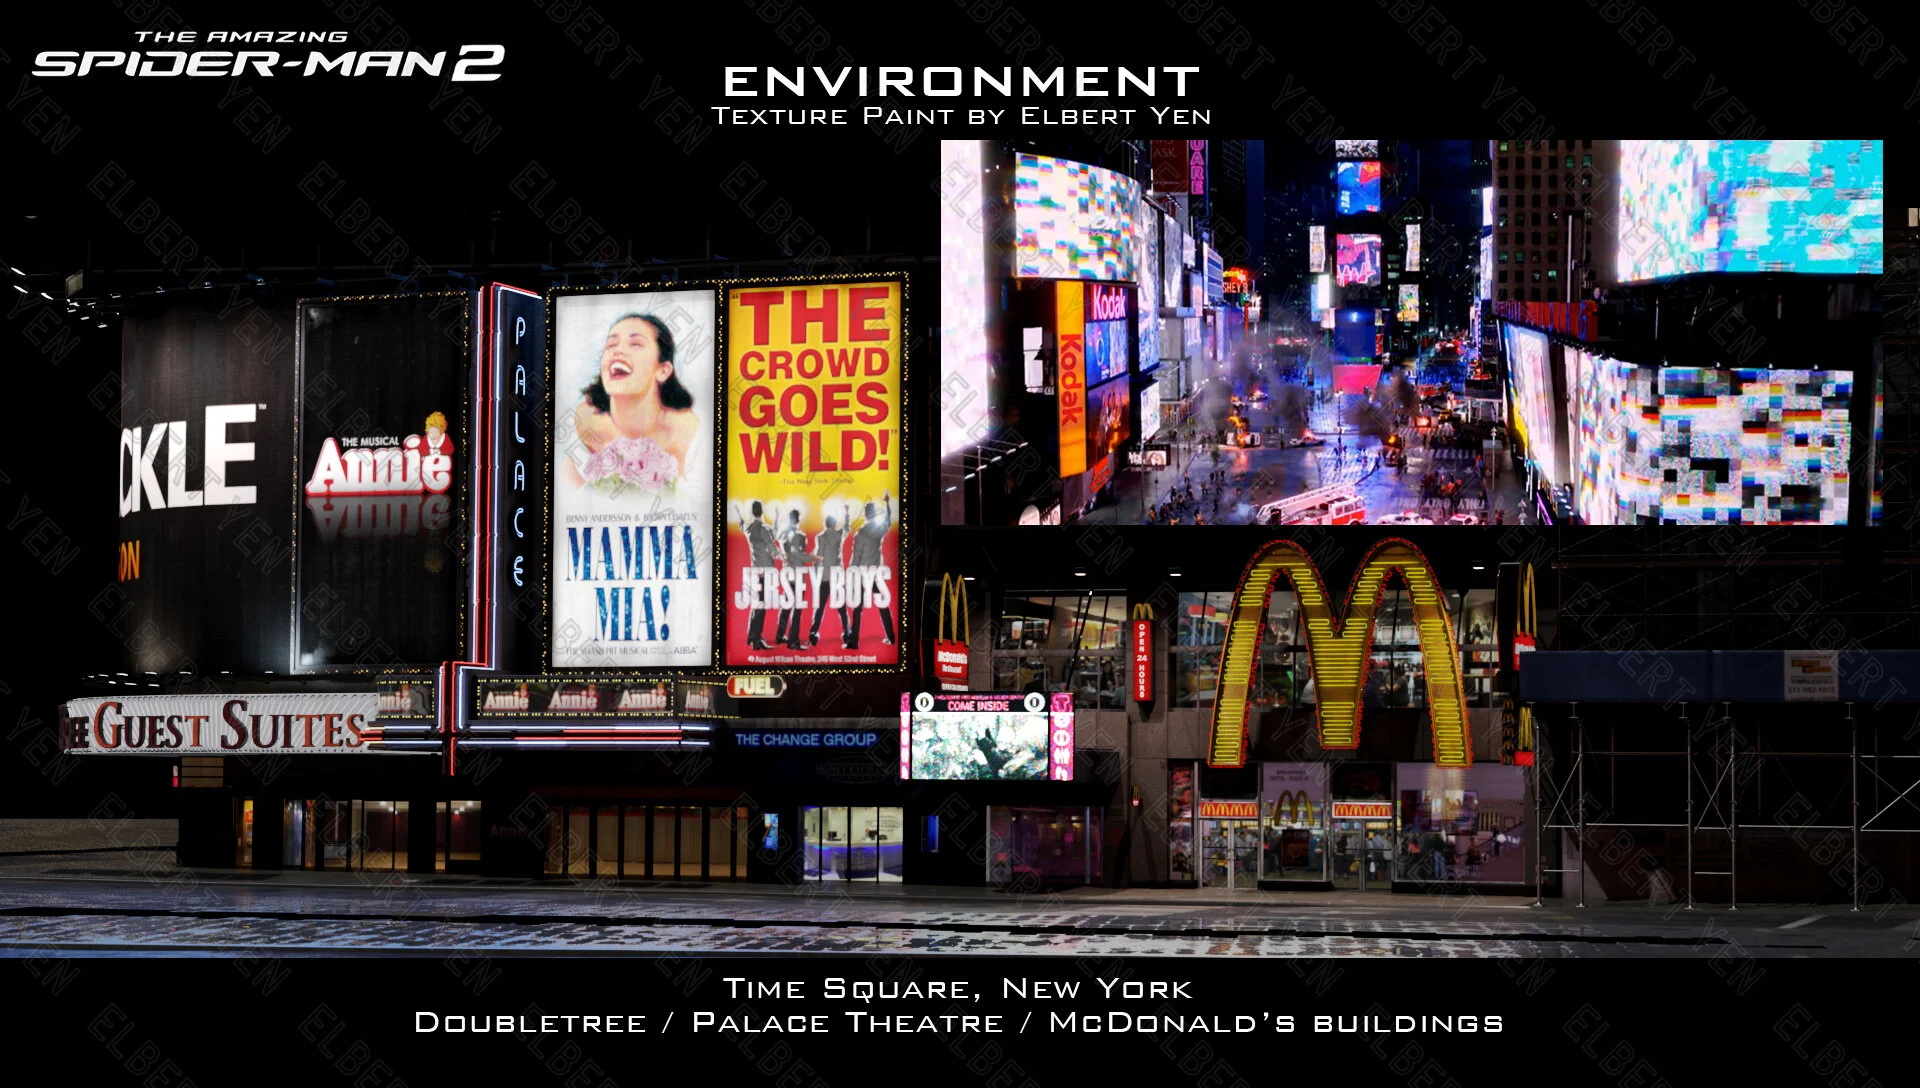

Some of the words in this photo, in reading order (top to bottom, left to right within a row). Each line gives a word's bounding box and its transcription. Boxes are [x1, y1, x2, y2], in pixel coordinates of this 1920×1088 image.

[1093, 284, 1126, 320] Kodak
[739, 348, 890, 381] CROWD
[1060, 333, 1084, 426] Kodak
[739, 381, 890, 428] GOES
[342, 437, 358, 447] THE
[360, 436, 399, 447] MUSICAL
[513, 316, 527, 588] PALACE
[305, 434, 453, 496] Annie
[118, 539, 141, 583] ON
[565, 525, 697, 582] MAMMA
[735, 565, 823, 611] JERSEY
[830, 565, 892, 609] BOYS
[593, 584, 671, 642] MIA!
[1138, 623, 1146, 652] OPEN
[1136, 654, 1148, 662] 24
[483, 690, 530, 711] Annie
[548, 689, 598, 711] Annie
[617, 687, 668, 710] Annie
[684, 690, 710, 711] Annie
[734, 677, 771, 696] FUEL
[1138, 664, 1146, 699] HOURS
[378, 691, 412, 712] nnie
[947, 700, 976, 712] COME
[976, 700, 1010, 712] INSIDE
[93, 701, 209, 750] GUEST
[220, 699, 365, 750] SUITES
[736, 733, 761, 747] THE
[762, 732, 820, 747] CHANGE
[823, 732, 877, 747] GROUP
